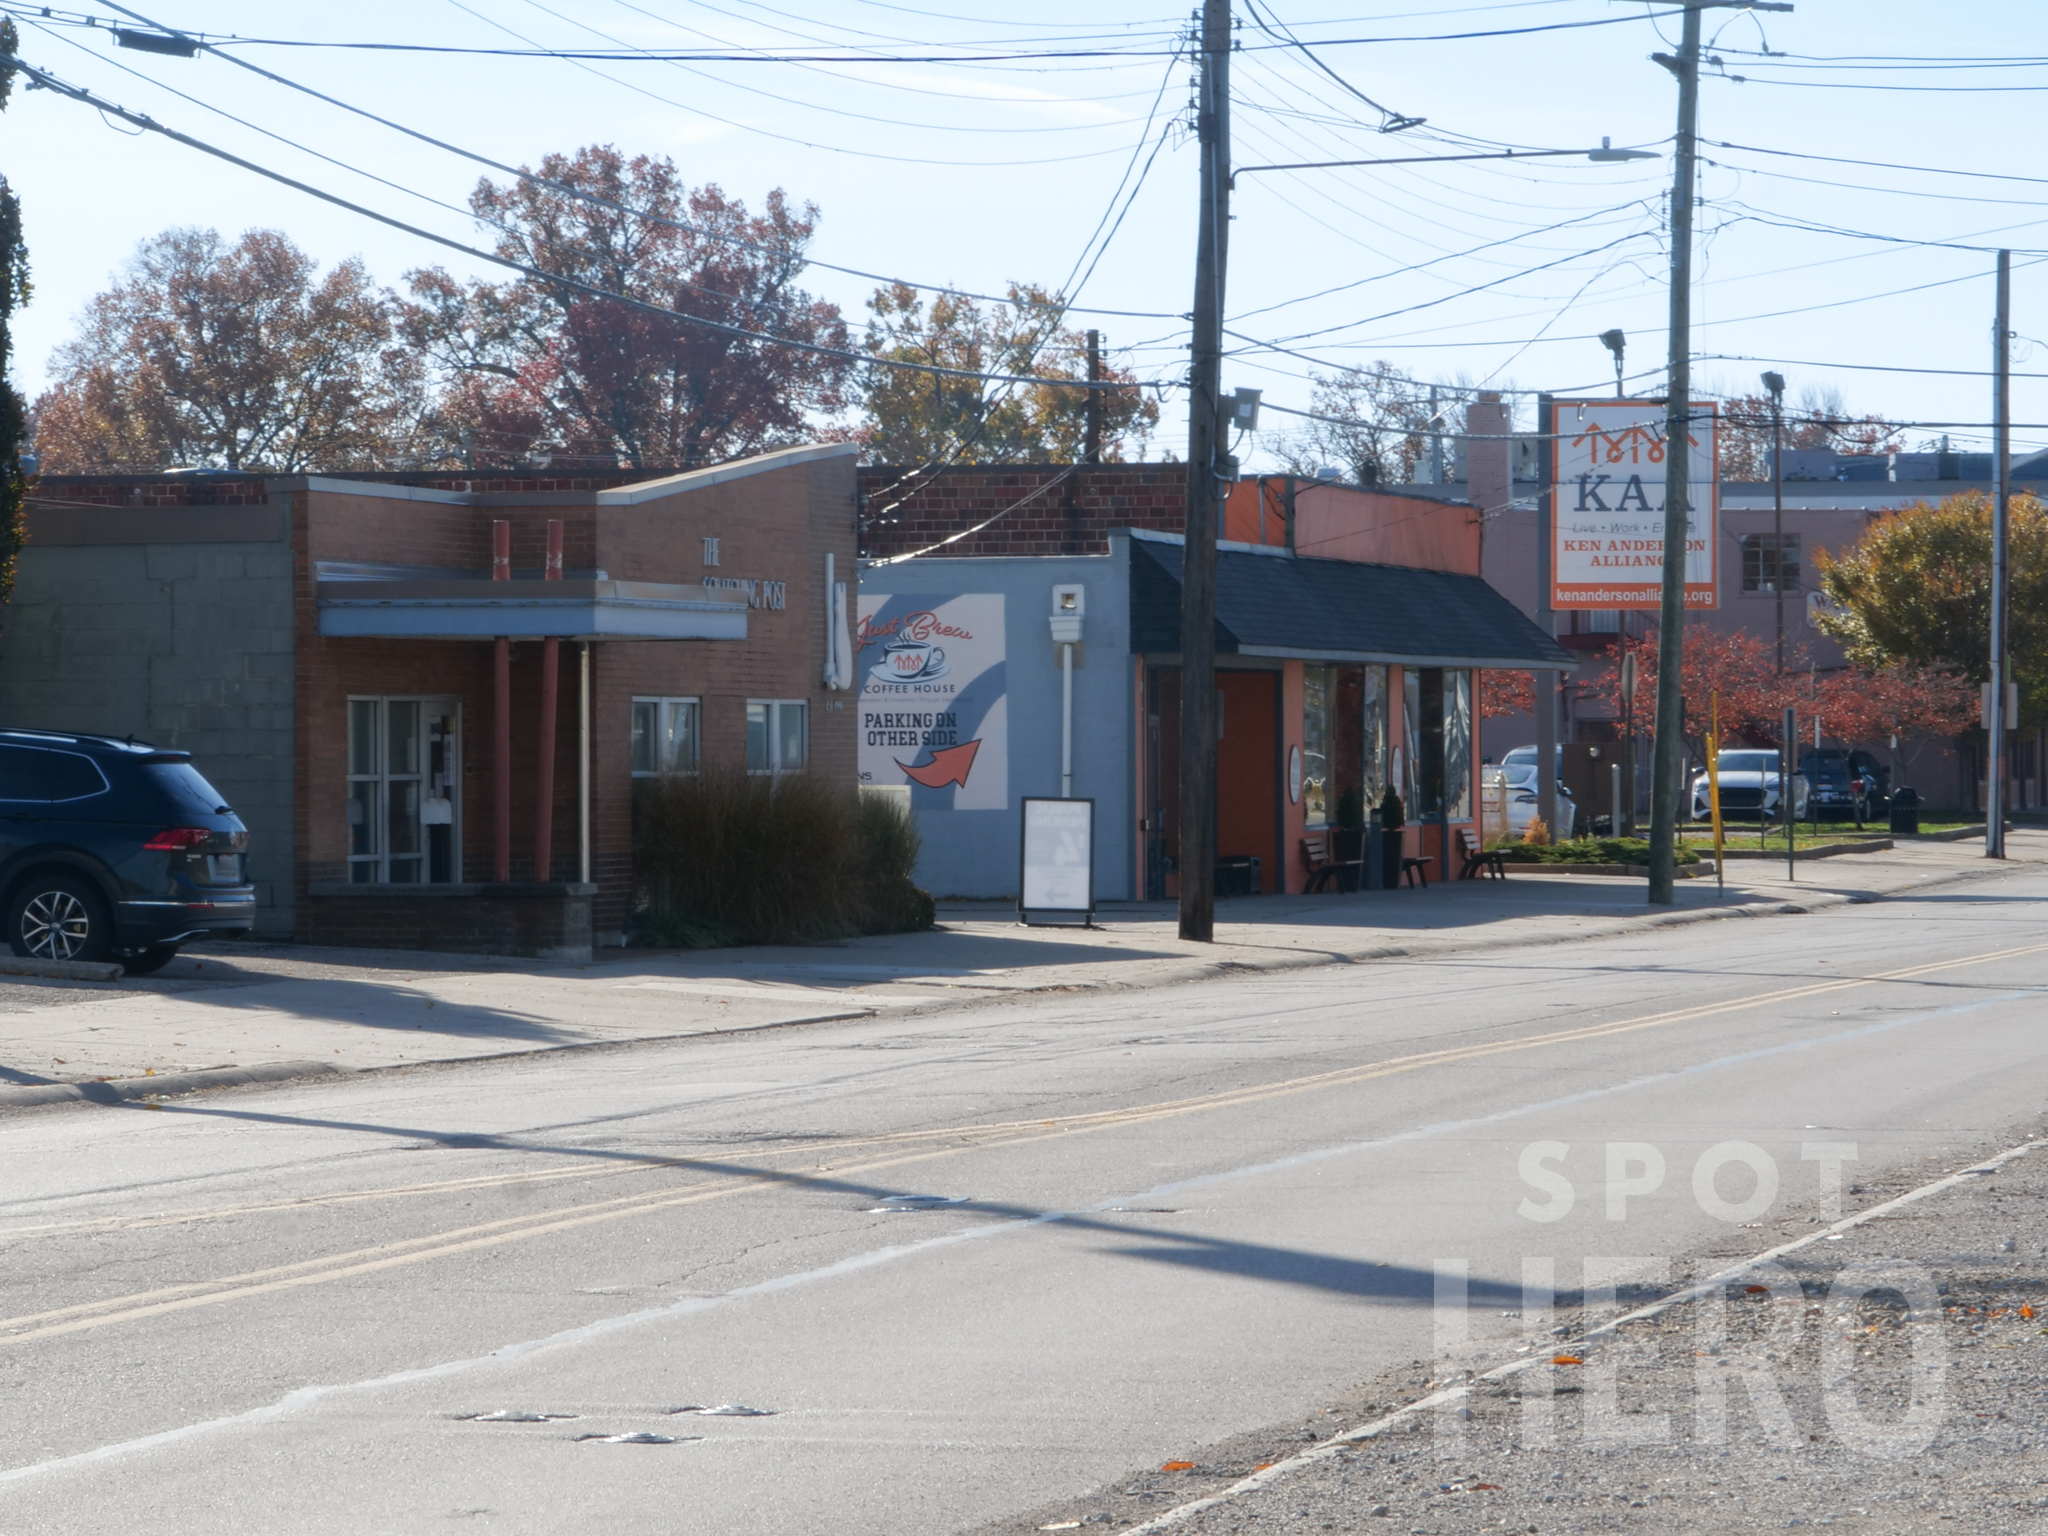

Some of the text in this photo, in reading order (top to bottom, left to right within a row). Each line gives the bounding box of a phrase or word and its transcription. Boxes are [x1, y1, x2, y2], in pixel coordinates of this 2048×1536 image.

[1572, 523, 1640, 533] Live Work
[1563, 540, 1602, 551] KEN
[763, 581, 787, 610] POST
[857, 610, 974, 653] Just Brew
[863, 684, 956, 694] COFFEE HOUSE
[864, 712, 958, 729] PARKING ON
[867, 731, 958, 747] OTHER SIDE
